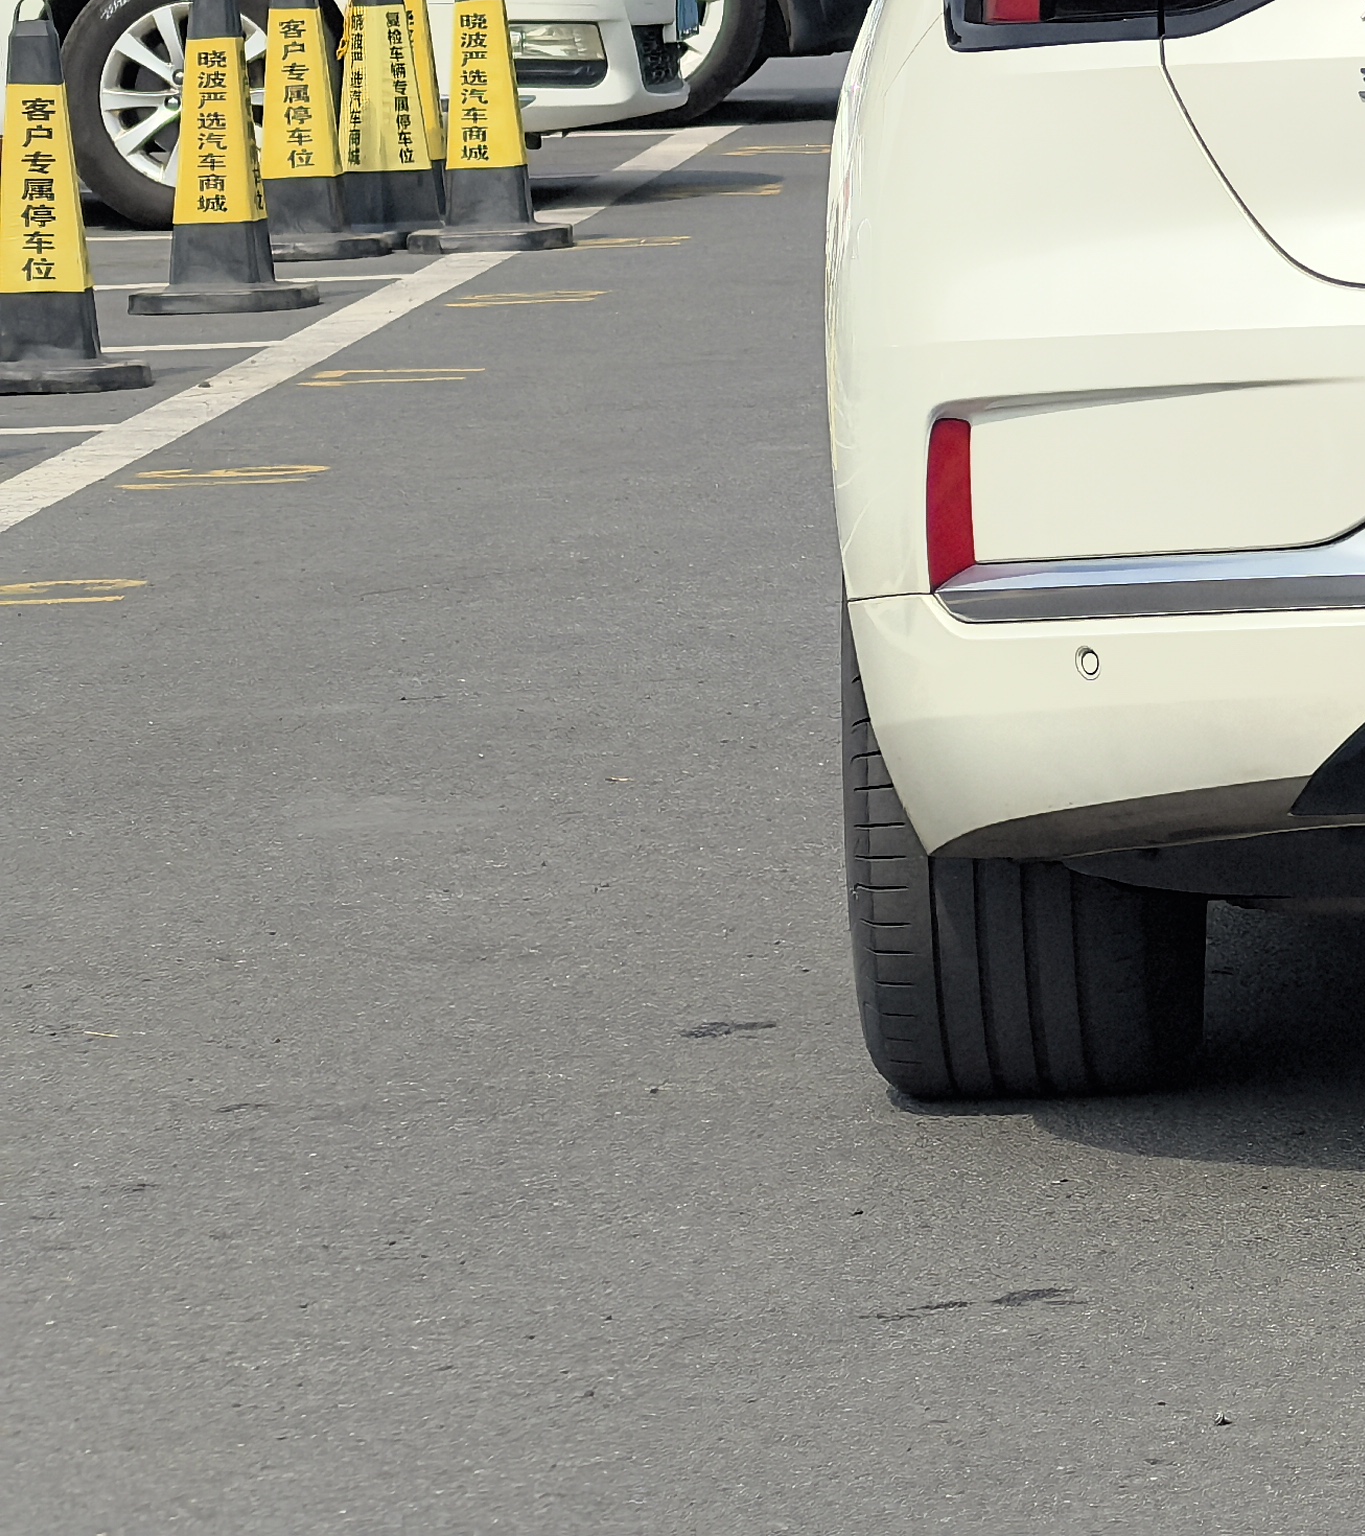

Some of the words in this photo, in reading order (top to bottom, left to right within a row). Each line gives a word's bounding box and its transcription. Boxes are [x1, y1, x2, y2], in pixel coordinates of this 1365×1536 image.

[197, 50, 228, 213] 晓波严选汽车商城
[278, 18, 316, 170] 客户专属停车位
[459, 12, 490, 163] 晓波严选汽车商城
[20, 97, 57, 283] 客户专属停车位
